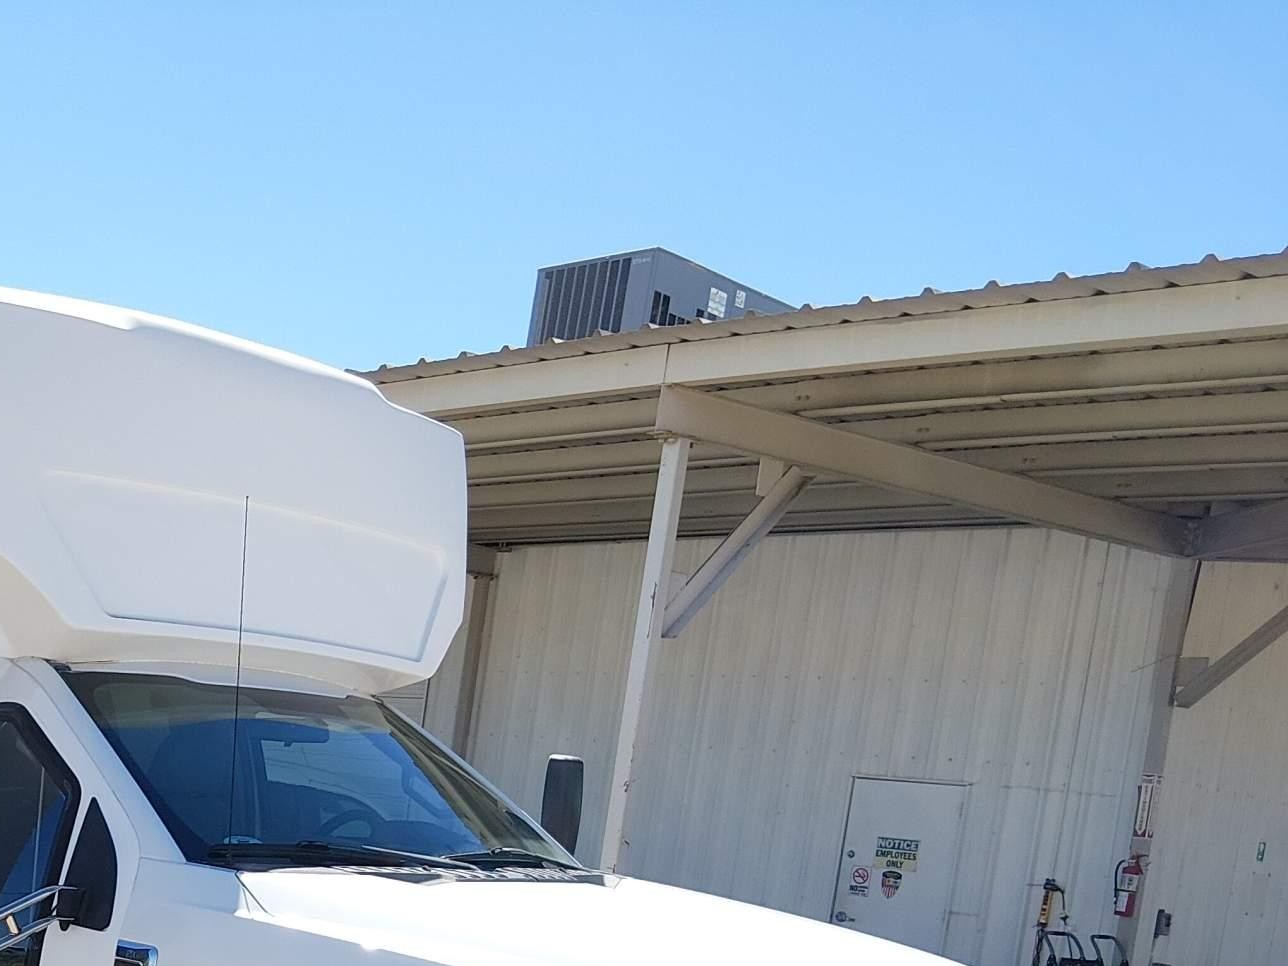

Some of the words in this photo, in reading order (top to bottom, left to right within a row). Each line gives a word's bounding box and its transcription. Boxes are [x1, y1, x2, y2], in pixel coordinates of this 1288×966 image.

[877, 839, 919, 851] NOTICE
[875, 850, 917, 860] EMPLOYEES
[885, 860, 904, 868] ONLY
